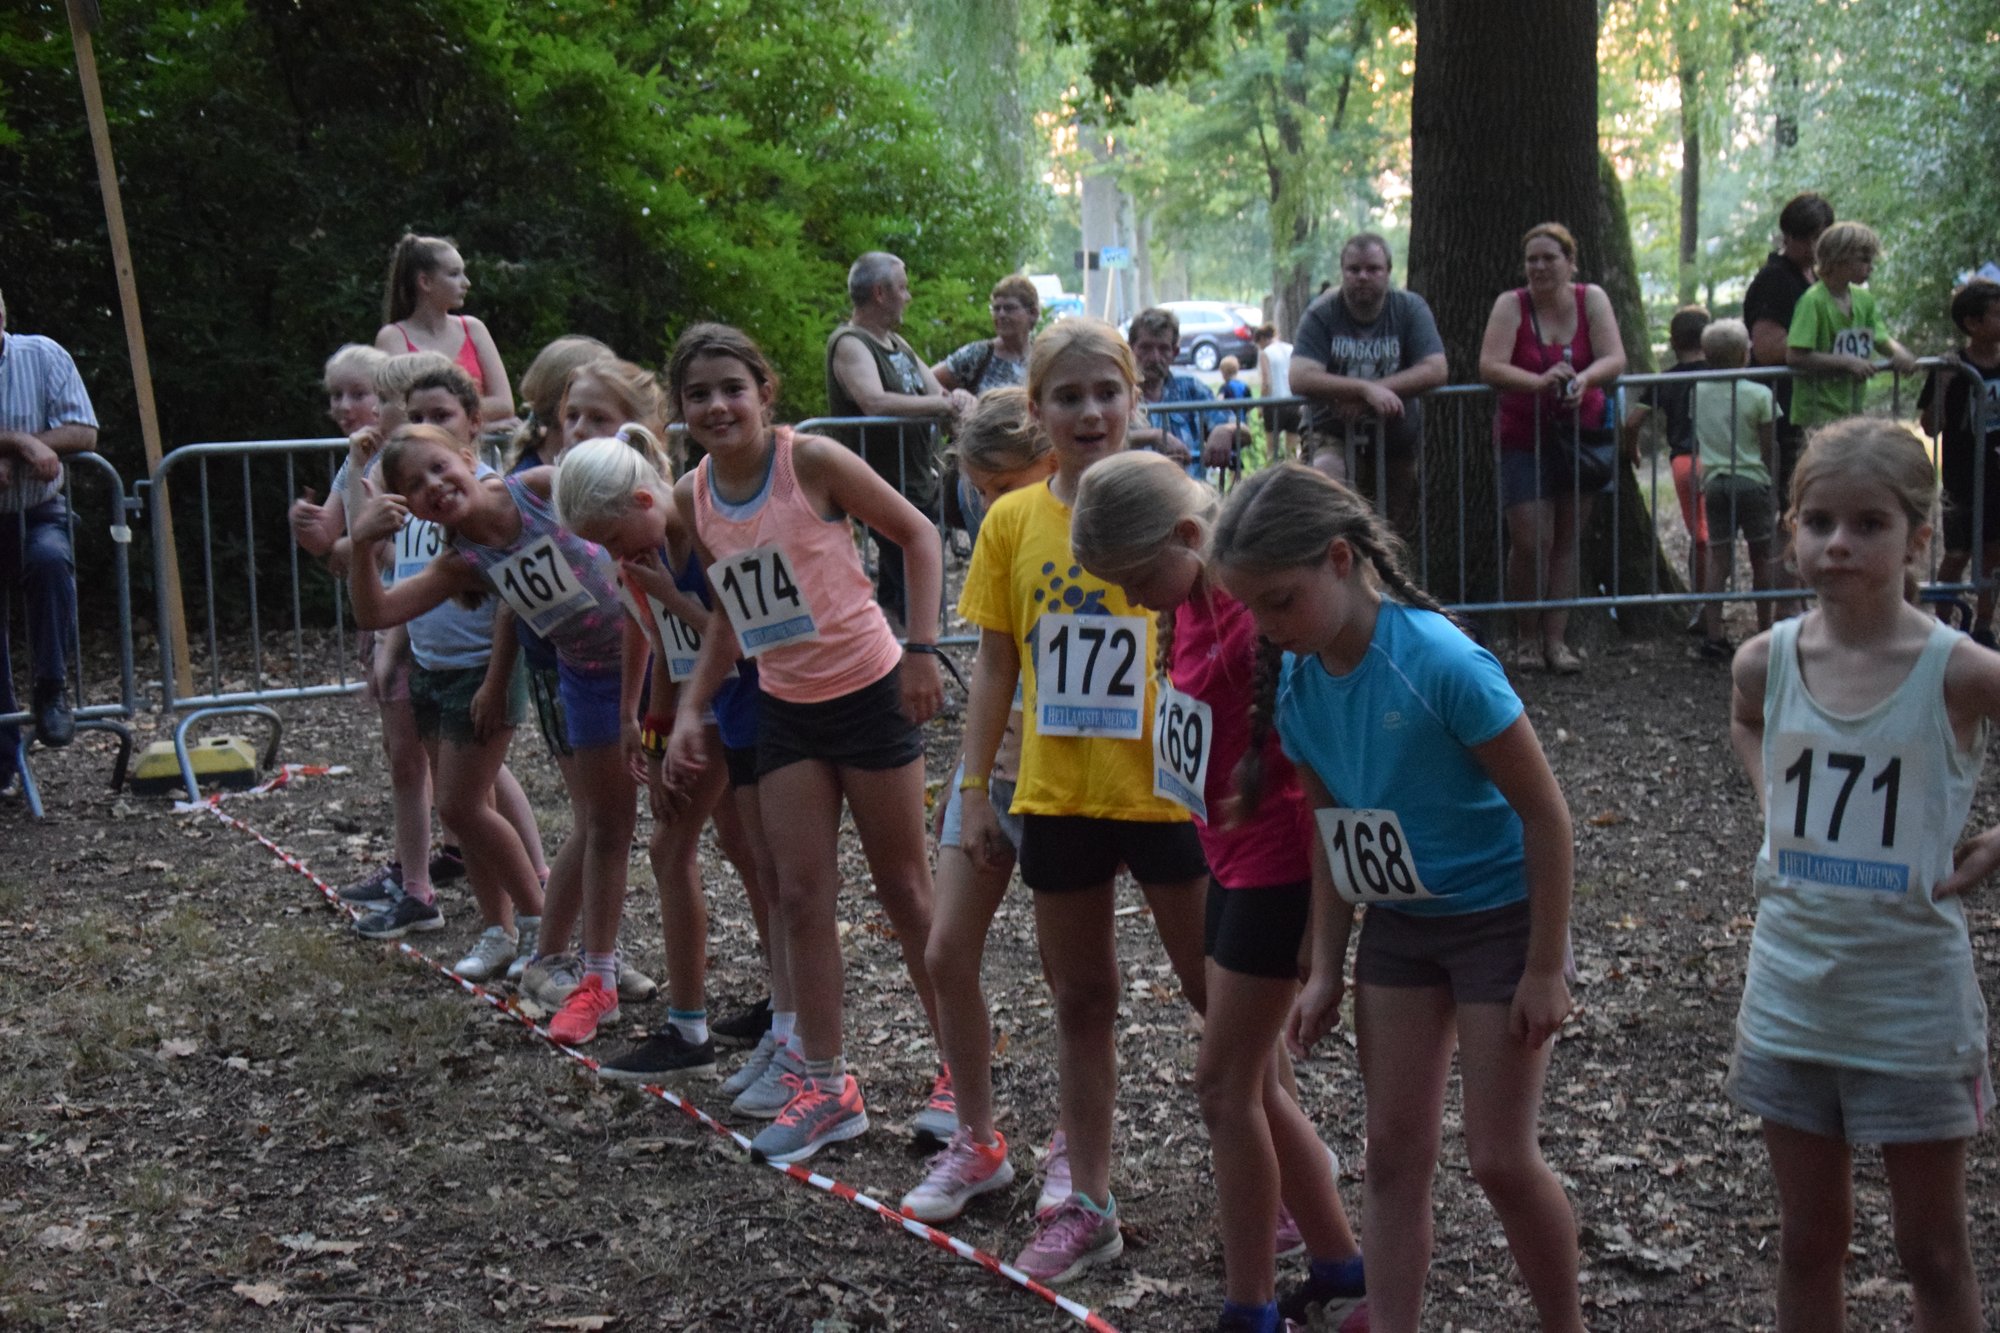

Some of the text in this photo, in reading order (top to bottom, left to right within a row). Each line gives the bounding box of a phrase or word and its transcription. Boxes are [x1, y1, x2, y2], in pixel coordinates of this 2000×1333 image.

[1331, 335, 1400, 360] HONGKONG
[1836, 332, 1870, 358] 193
[504, 545, 567, 609] 167
[722, 552, 800, 620] 174
[662, 607, 702, 652] 16
[1049, 625, 1137, 697] 172
[1159, 693, 1203, 784] 169
[1785, 748, 1901, 848] 171
[1333, 819, 1416, 894] 168
